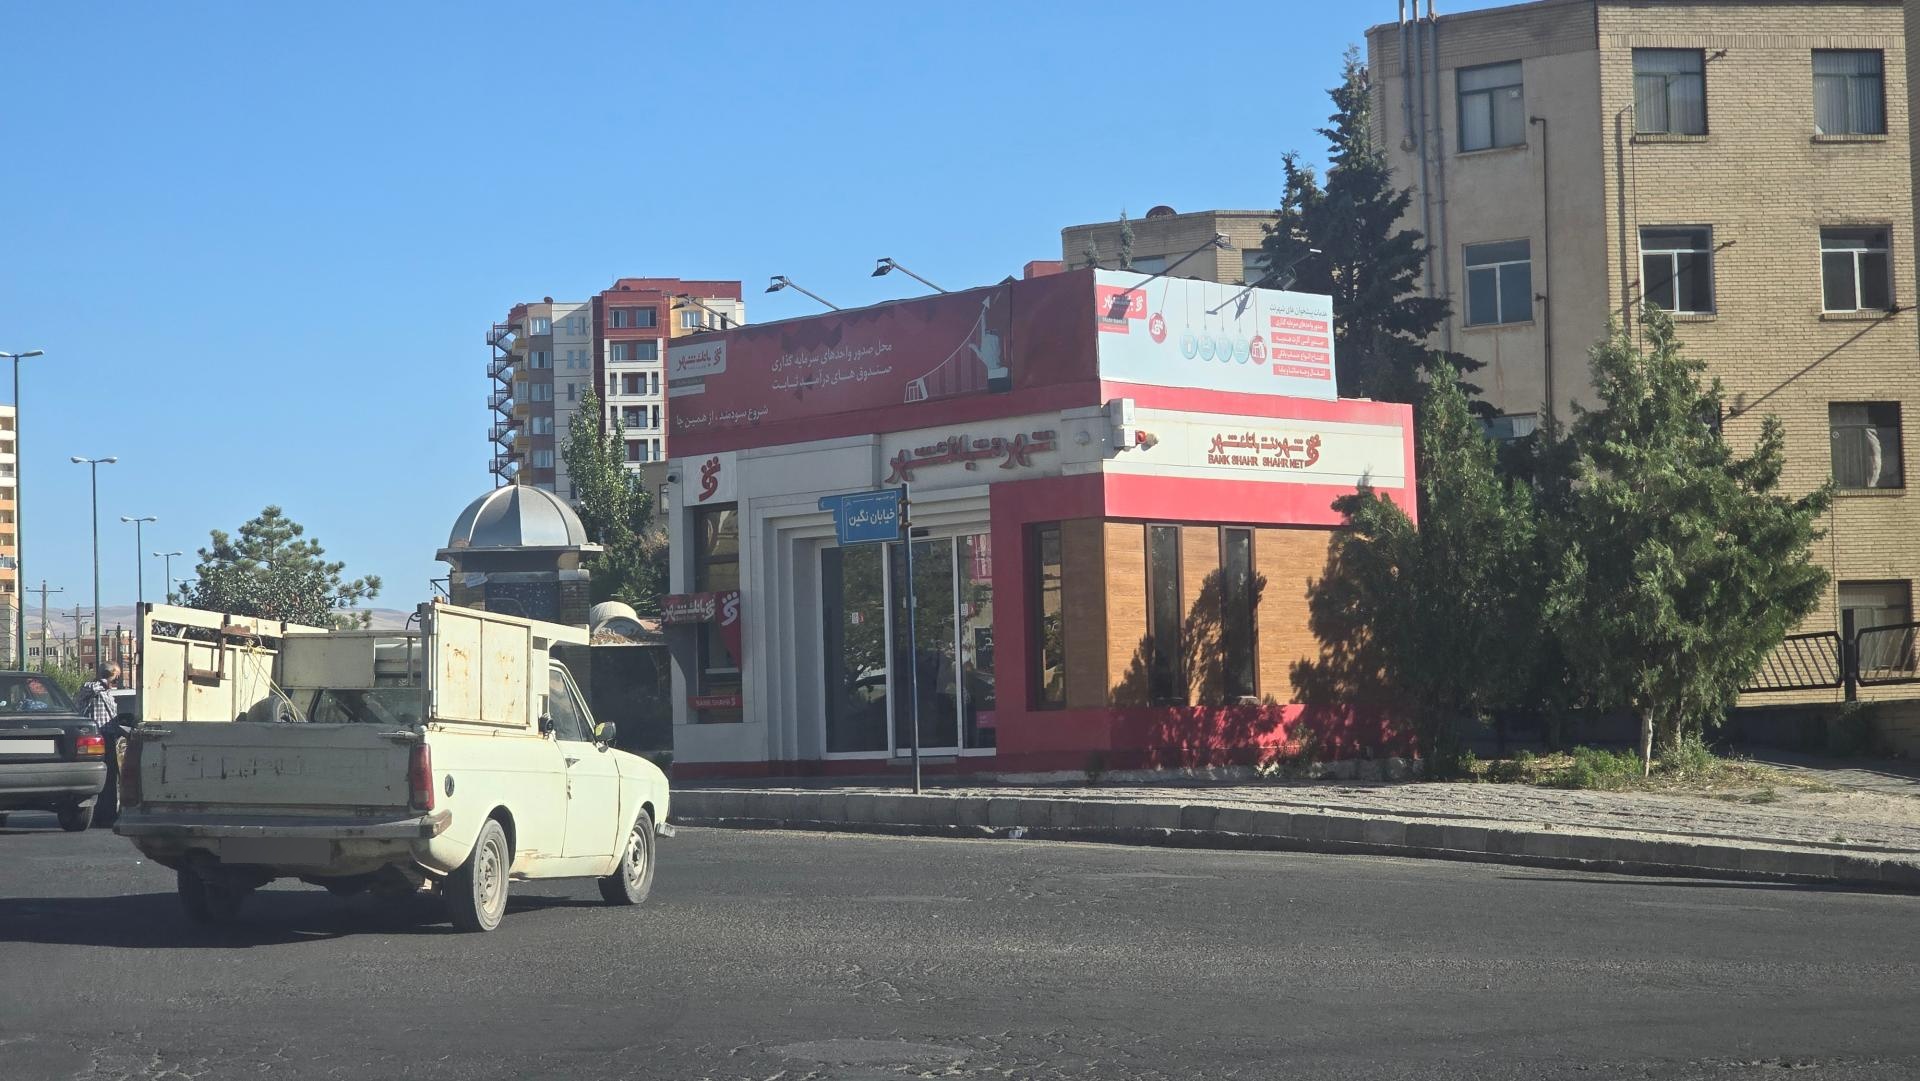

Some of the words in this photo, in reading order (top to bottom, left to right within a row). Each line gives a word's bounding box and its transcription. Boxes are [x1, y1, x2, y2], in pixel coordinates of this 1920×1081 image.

[821, 346, 852, 364] واحدهای
[854, 345, 874, 361] صدور
[876, 339, 893, 356] محل
[772, 354, 792, 372] گذاری
[794, 352, 819, 369] سرمایه
[856, 364, 893, 382] صندوق
[748, 405, 768, 421] شروع
[1208, 454, 1230, 465] BANK
[1232, 456, 1258, 466] SHAHR
[1262, 457, 1288, 468] SHAHR
[1290, 458, 1304, 469] NET
[848, 509, 869, 526] نگین
[870, 508, 895, 524] خیابان
